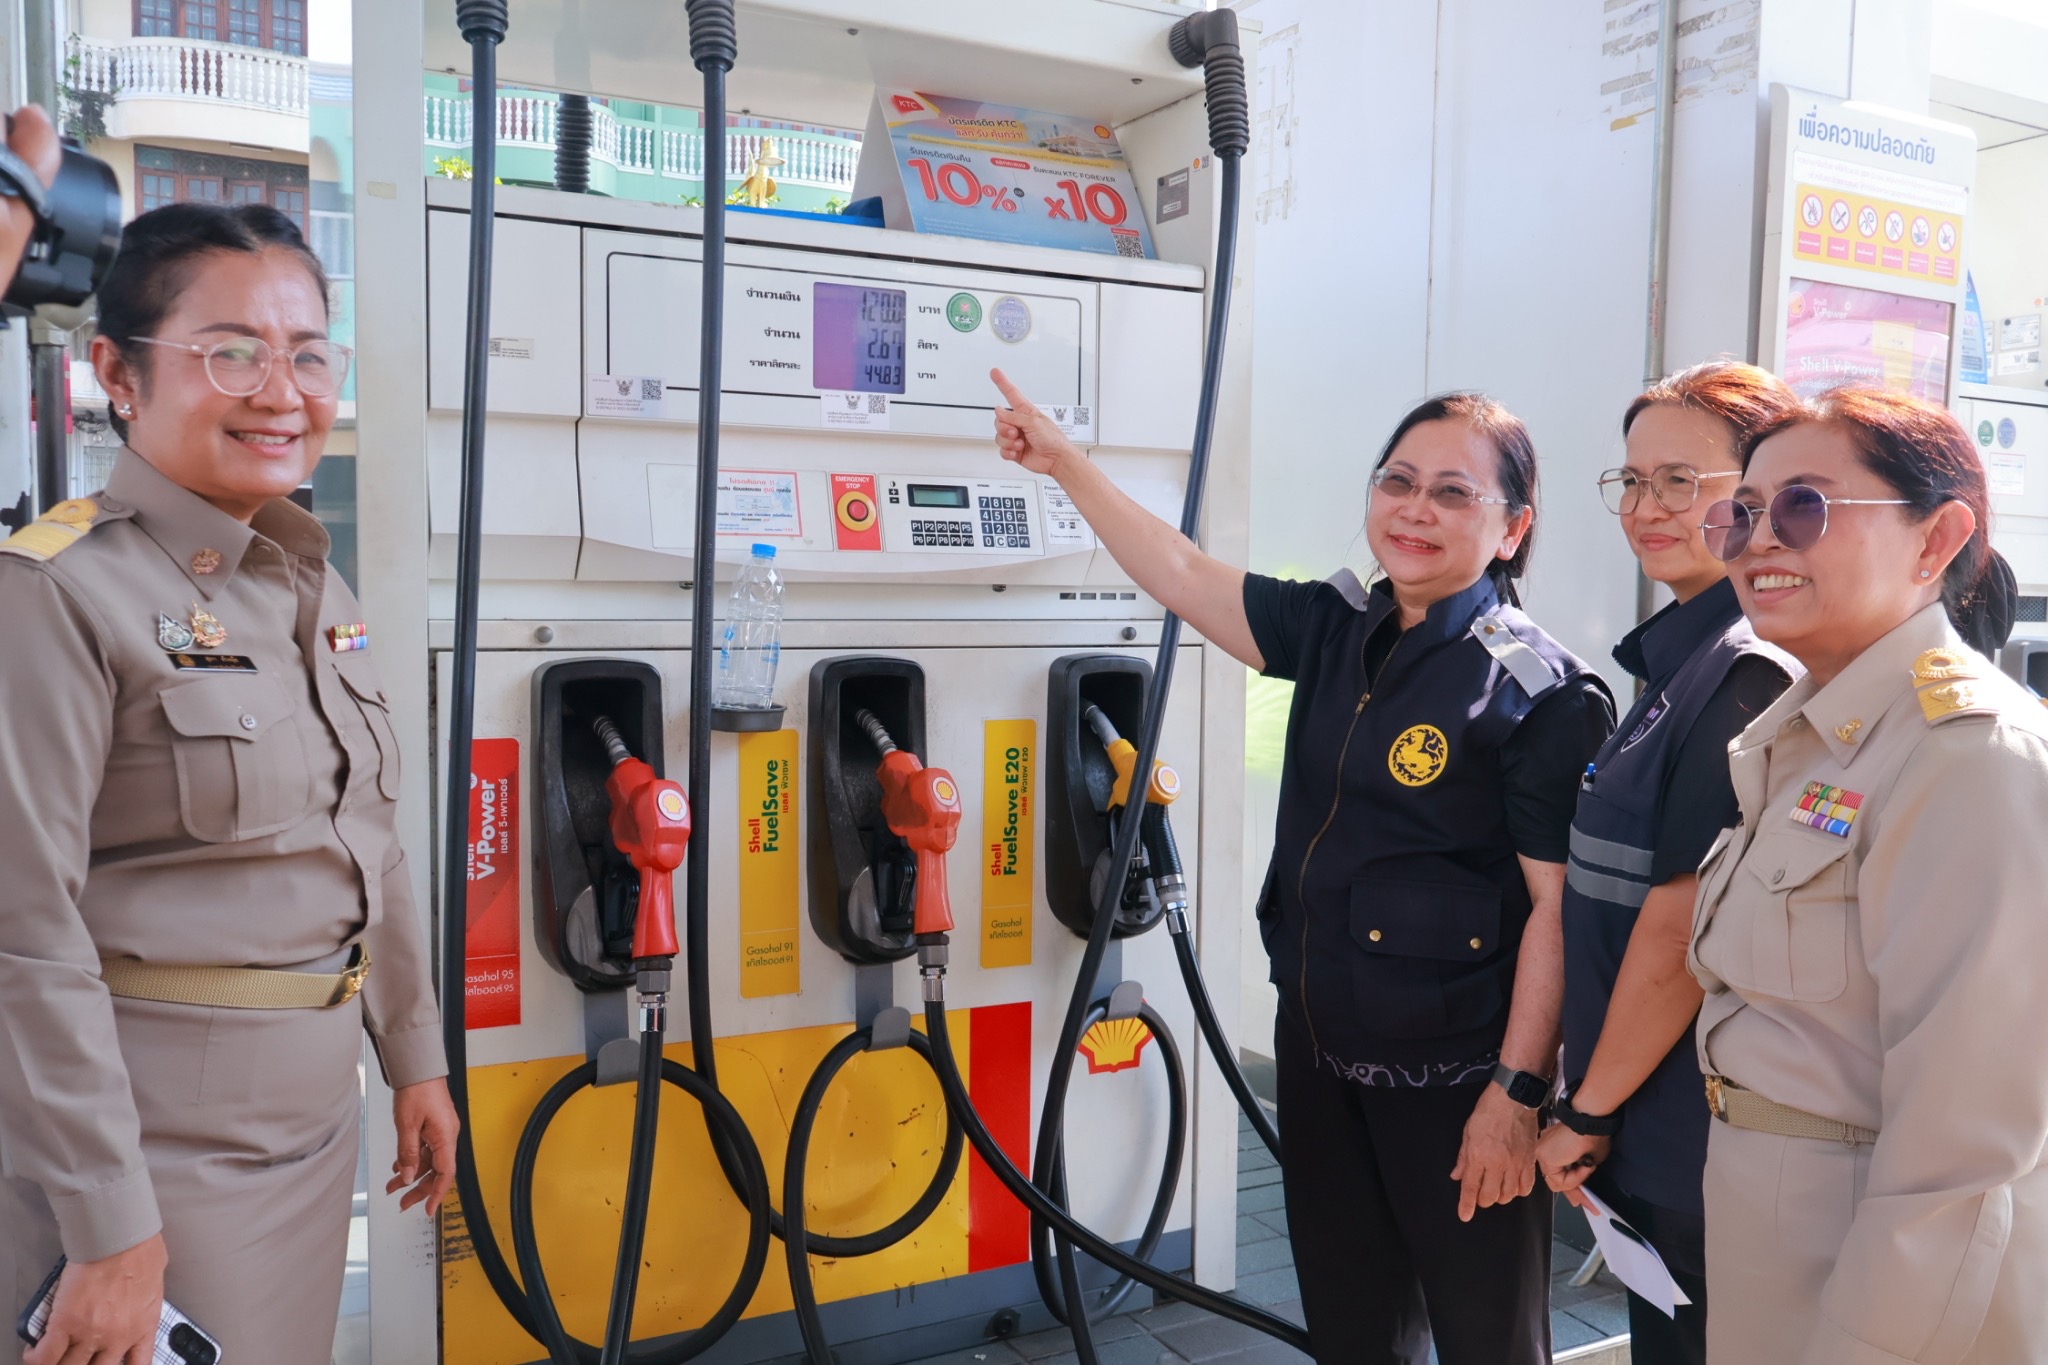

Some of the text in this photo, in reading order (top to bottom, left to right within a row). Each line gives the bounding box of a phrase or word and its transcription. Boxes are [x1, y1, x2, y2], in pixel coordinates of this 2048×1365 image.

[899, 100, 918, 109] KTC
[948, 117, 1018, 128] บัตรเครดิต KTC
[1798, 104, 1936, 165] เพื่อความปลอดภัย
[1063, 171, 1079, 179] KTC
[1081, 174, 1117, 183] FOREVER
[907, 157, 1018, 214] 10%
[1043, 179, 1128, 227] x10
[746, 288, 802, 302] จำนวนเงิน
[1813, 297, 1827, 306] Shell
[918, 304, 941, 316] บาท
[1813, 306, 1848, 319] V-Power
[763, 326, 801, 340] จำนวน
[867, 327, 904, 360] 2.67
[917, 339, 939, 351] ลิตร
[749, 358, 802, 371] ราคาลิตรละ
[1800, 356, 1880, 378] Shell V-Power
[864, 363, 902, 386] 44.83
[917, 371, 937, 381] บาท
[835, 475, 870, 484] EMERGENCY
[845, 482, 861, 490] STOP
[981, 498, 1024, 509] 7 8 9 F1
[982, 510, 1026, 521] 4 5 6 F2
[912, 522, 972, 532] P1 P2 P3 P4 P5
[996, 524, 1003, 534] 2
[1008, 525, 1015, 534] 3
[1018, 526, 1027, 534] F3
[913, 535, 974, 545] P6 P7 P8 P9 P10
[985, 536, 1029, 548] 0 C F4
[1021, 746, 1029, 762] E20
[761, 759, 779, 853] FuelSave
[781, 792, 789, 814] เชลล์
[1020, 796, 1028, 816] เชลล์
[498, 778, 508, 854] เชลล์ วี-เพาเวอร์
[1002, 747, 1020, 876] FuelSave E20
[476, 778, 496, 881] V-Power
[748, 818, 761, 853] Shell
[991, 843, 1002, 876] Shell
[991, 916, 1023, 929] Gasohol
[746, 942, 793, 956] Gasohol 91
[785, 955, 794, 963] 91
[465, 969, 514, 983] asohol 95
[503, 984, 514, 992] 95
